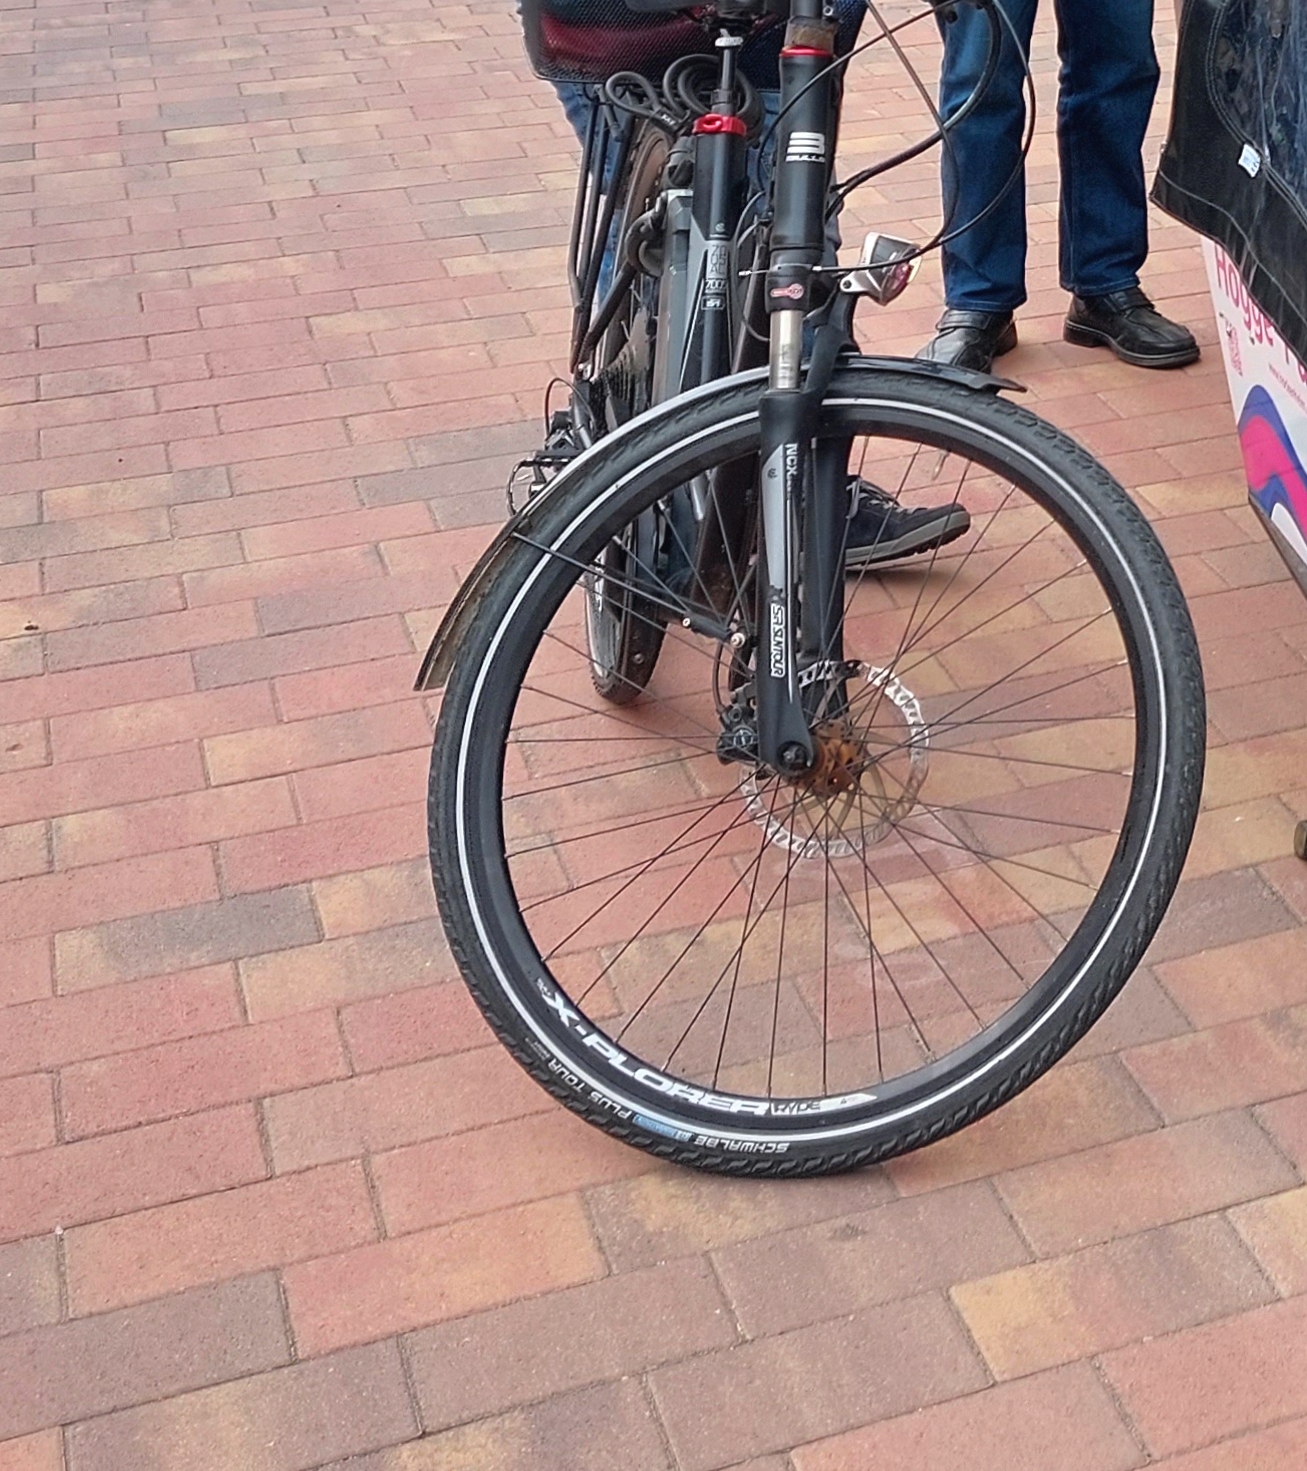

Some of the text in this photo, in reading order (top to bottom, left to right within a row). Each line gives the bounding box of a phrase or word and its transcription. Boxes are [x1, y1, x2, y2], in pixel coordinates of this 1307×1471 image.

[541, 991, 771, 1116] X-PLORER
[548, 1058, 790, 1154] SCHWALBE PLUS TOUR
